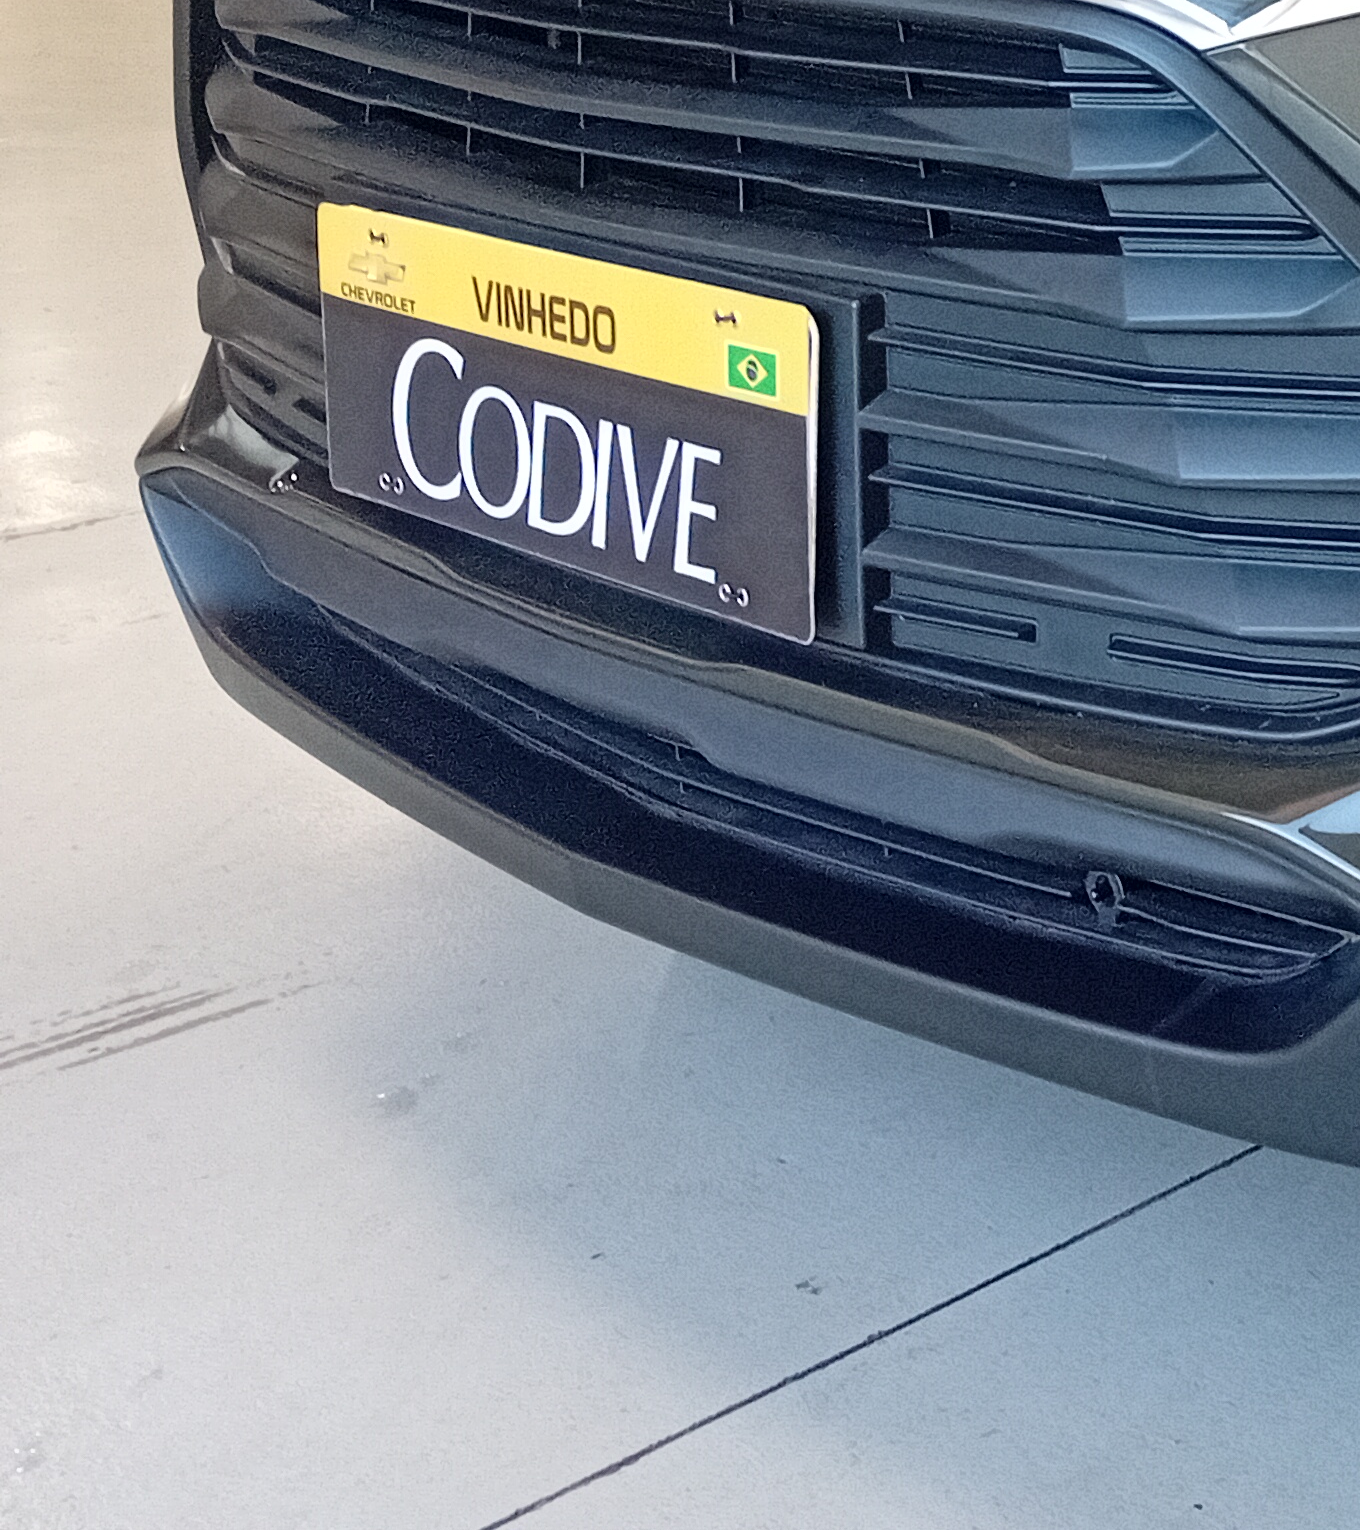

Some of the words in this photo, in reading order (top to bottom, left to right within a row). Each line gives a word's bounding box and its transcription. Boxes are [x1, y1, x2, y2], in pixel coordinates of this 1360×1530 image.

[340, 281, 416, 315] CHEVROLET
[471, 276, 617, 355] VINHEDO
[390, 337, 723, 585] CODIVE
